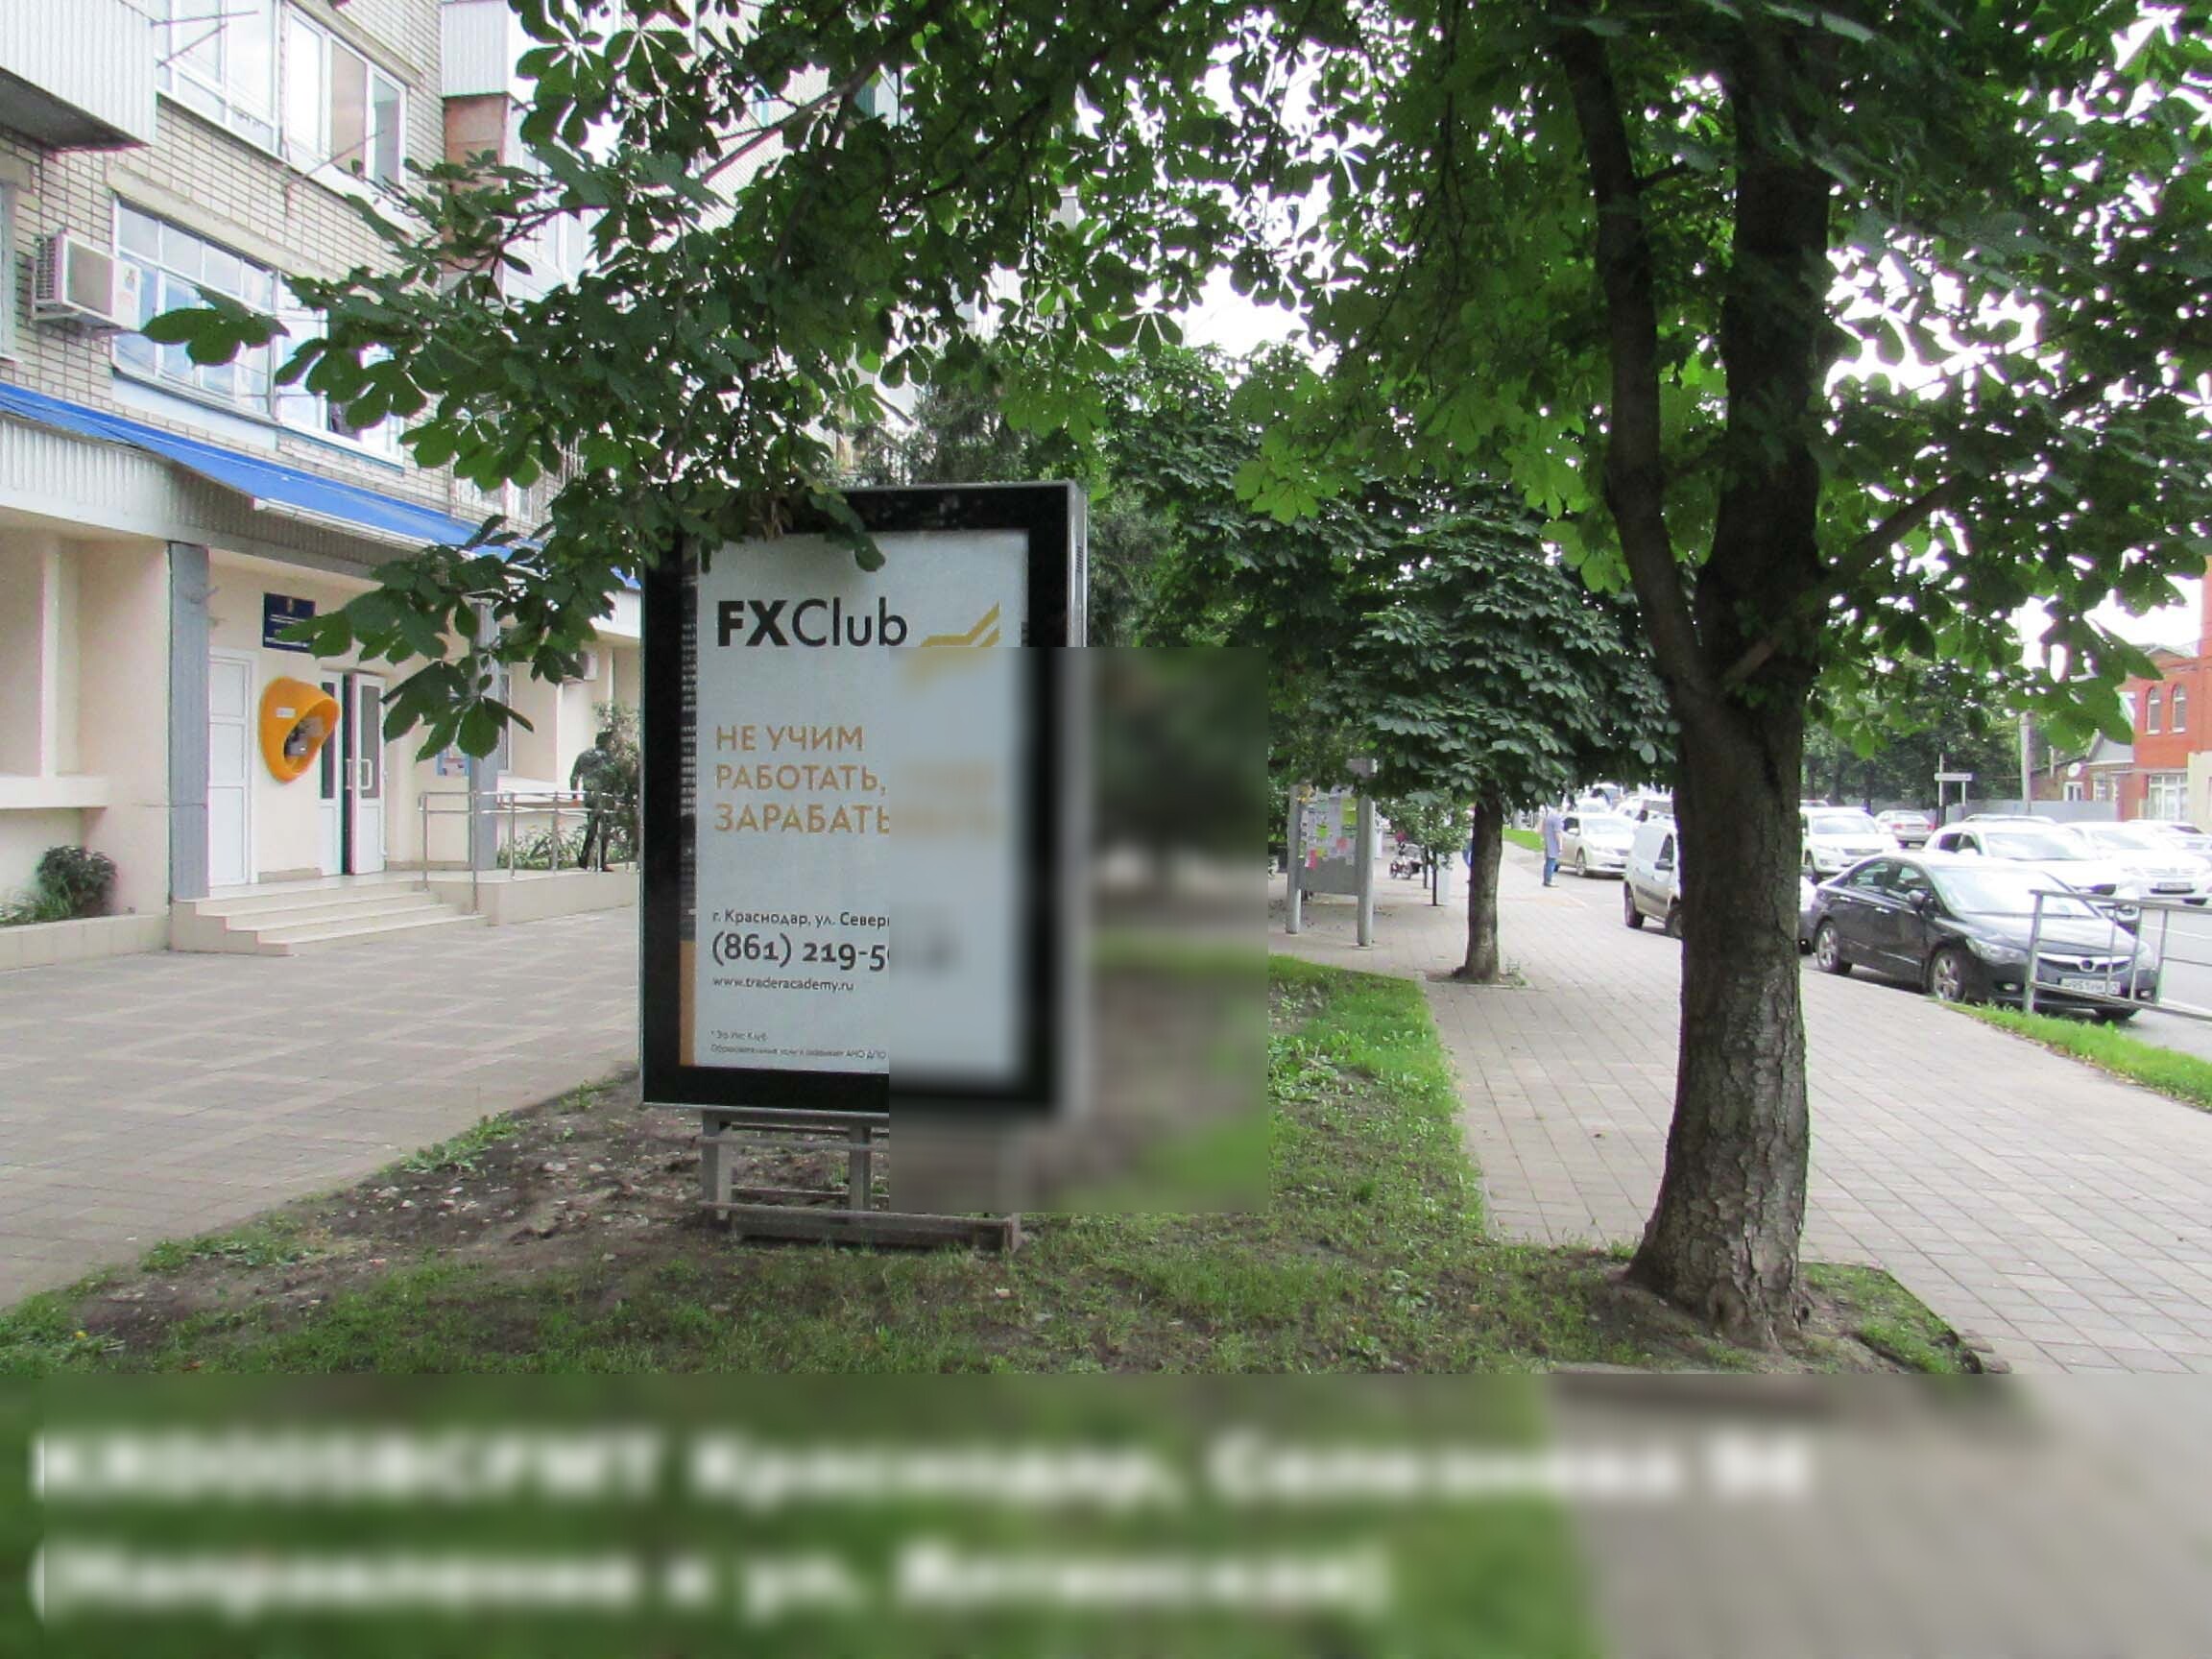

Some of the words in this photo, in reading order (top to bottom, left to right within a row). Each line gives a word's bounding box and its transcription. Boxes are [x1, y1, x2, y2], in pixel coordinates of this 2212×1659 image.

[717, 596, 908, 648] FXClub
[715, 725, 757, 752] НЕ
[766, 725, 864, 752] УЧИМ
[715, 764, 888, 797] РАБОТАТЬ,
[711, 911, 721, 923] г.
[724, 908, 812, 928] Краснодар,
[813, 913, 836, 928] ул.
[839, 911, 890, 930] Север
[711, 930, 793, 969] (861)
[801, 941, 890, 972] 219-5
[712, 975, 854, 993] www.traderacademy.ru
